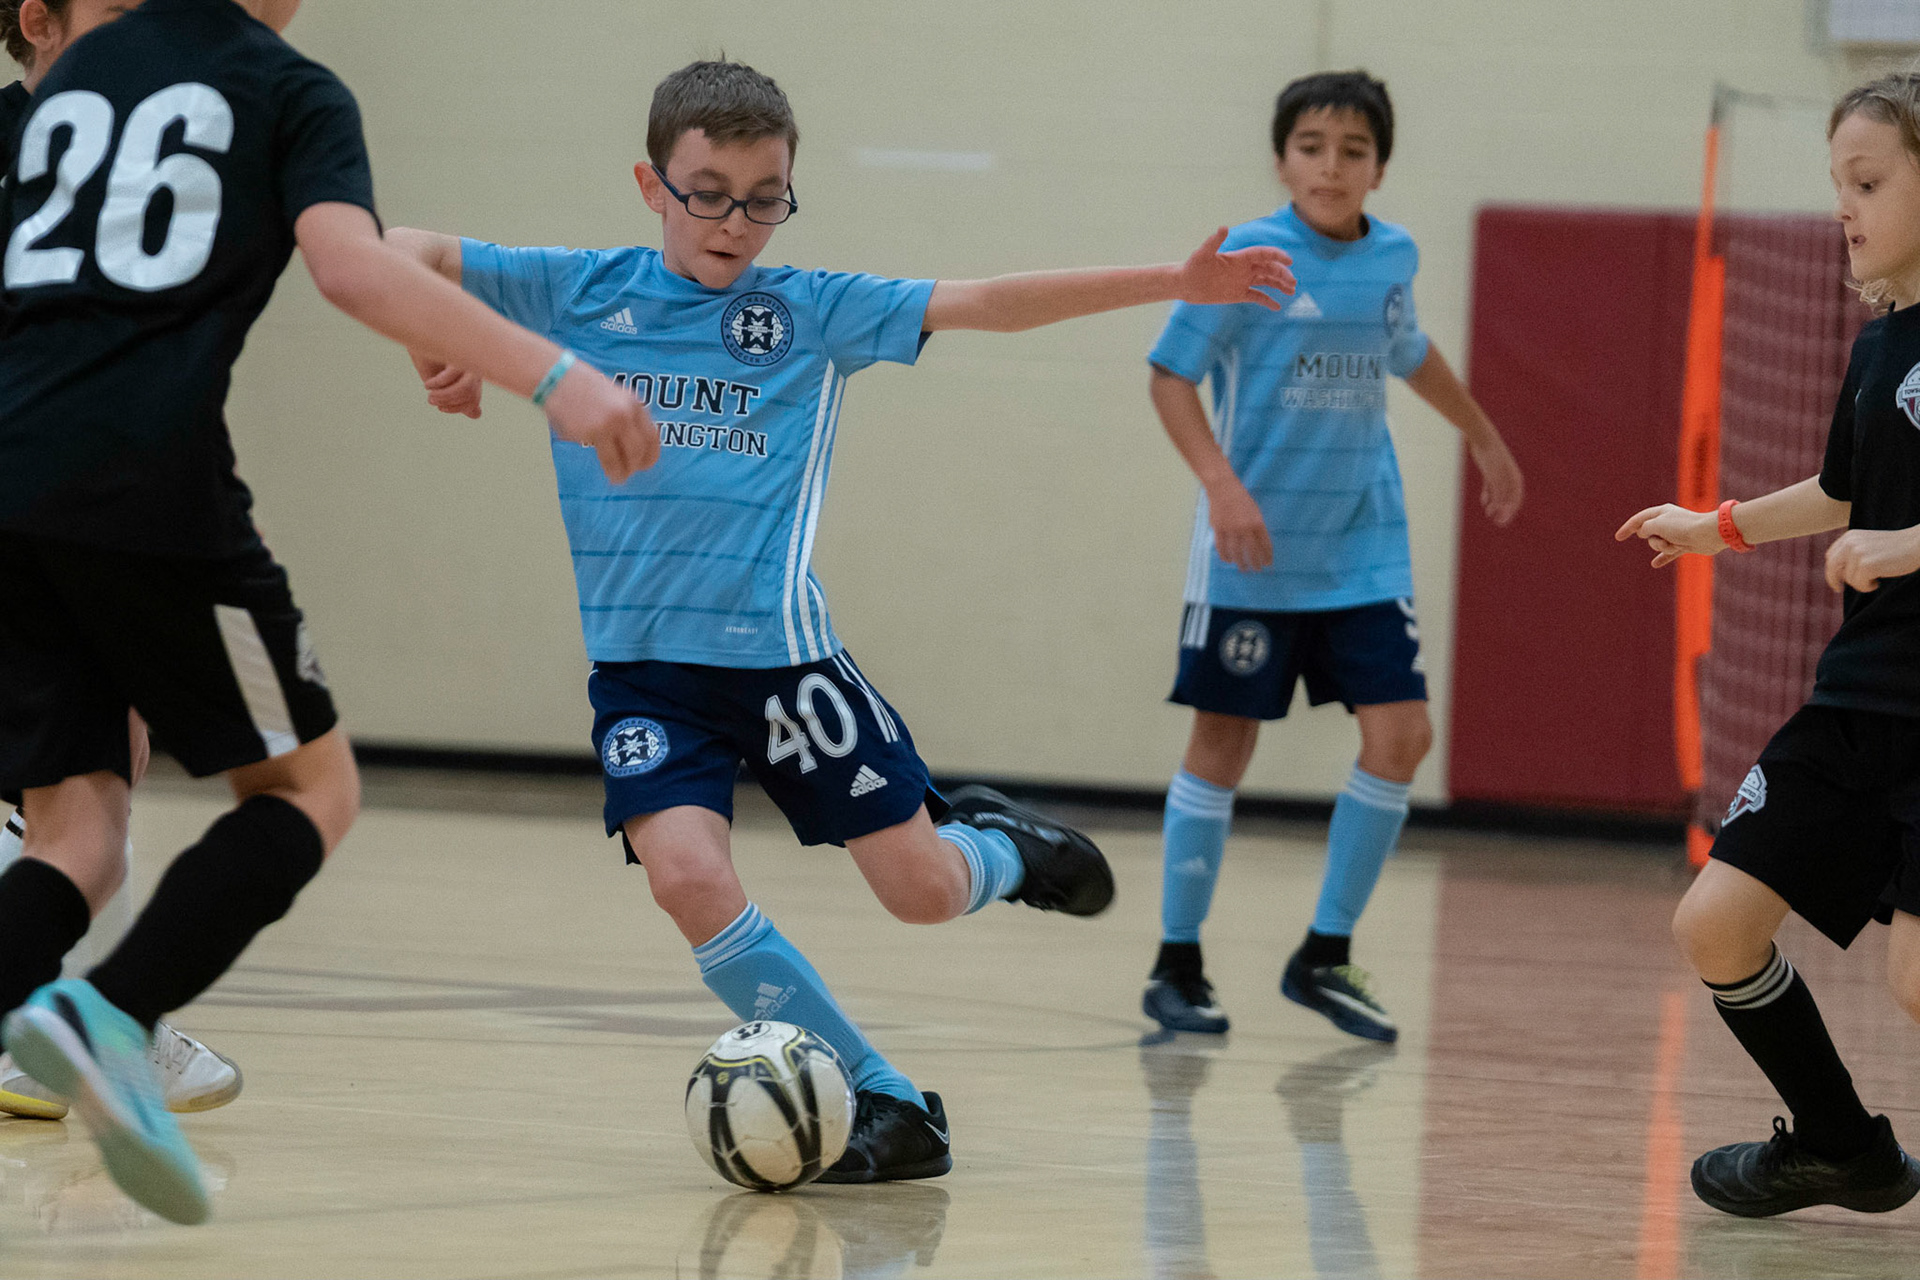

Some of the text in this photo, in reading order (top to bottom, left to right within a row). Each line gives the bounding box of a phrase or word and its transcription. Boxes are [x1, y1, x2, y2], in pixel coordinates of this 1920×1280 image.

[4, 81, 235, 292] 26
[600, 319, 638, 335] adidas
[1293, 352, 1388, 381] MOUN
[600, 372, 760, 416] OUNT
[765, 673, 858, 774] 40
[850, 777, 888, 797] adidas
[761, 985, 797, 1020] didas
